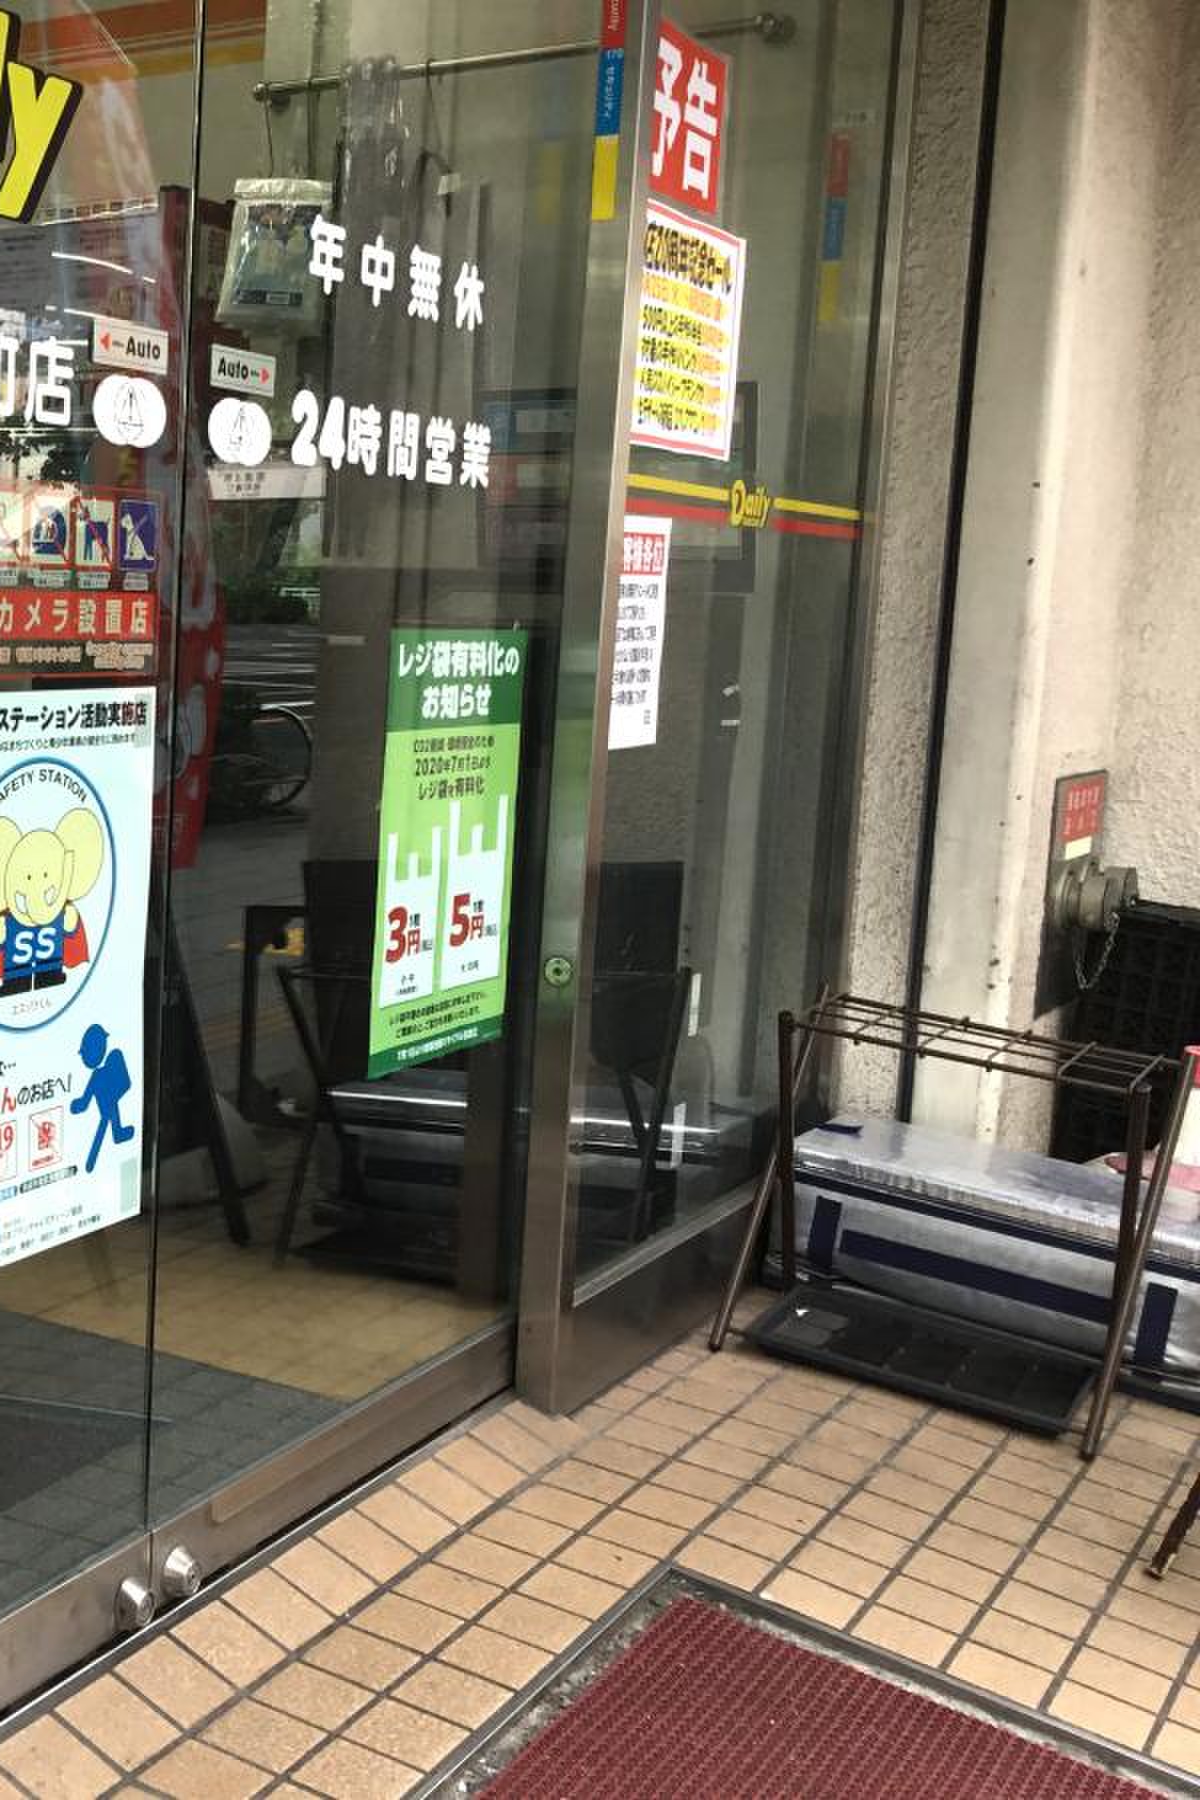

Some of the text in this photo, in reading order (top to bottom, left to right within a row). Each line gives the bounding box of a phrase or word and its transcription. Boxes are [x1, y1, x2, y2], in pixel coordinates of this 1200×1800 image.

[652, 37, 717, 199] 予告
[308, 214, 485, 331] 年中無休
[126, 337, 161, 360] Auto
[217, 358, 249, 381] Auto
[290, 389, 493, 489] 24時間営業
[399, 640, 520, 678] レジ袋有料化の
[421, 684, 492, 720] お知らせ
[38, 769, 87, 802] STATION
[12, 927, 56, 963] SS
